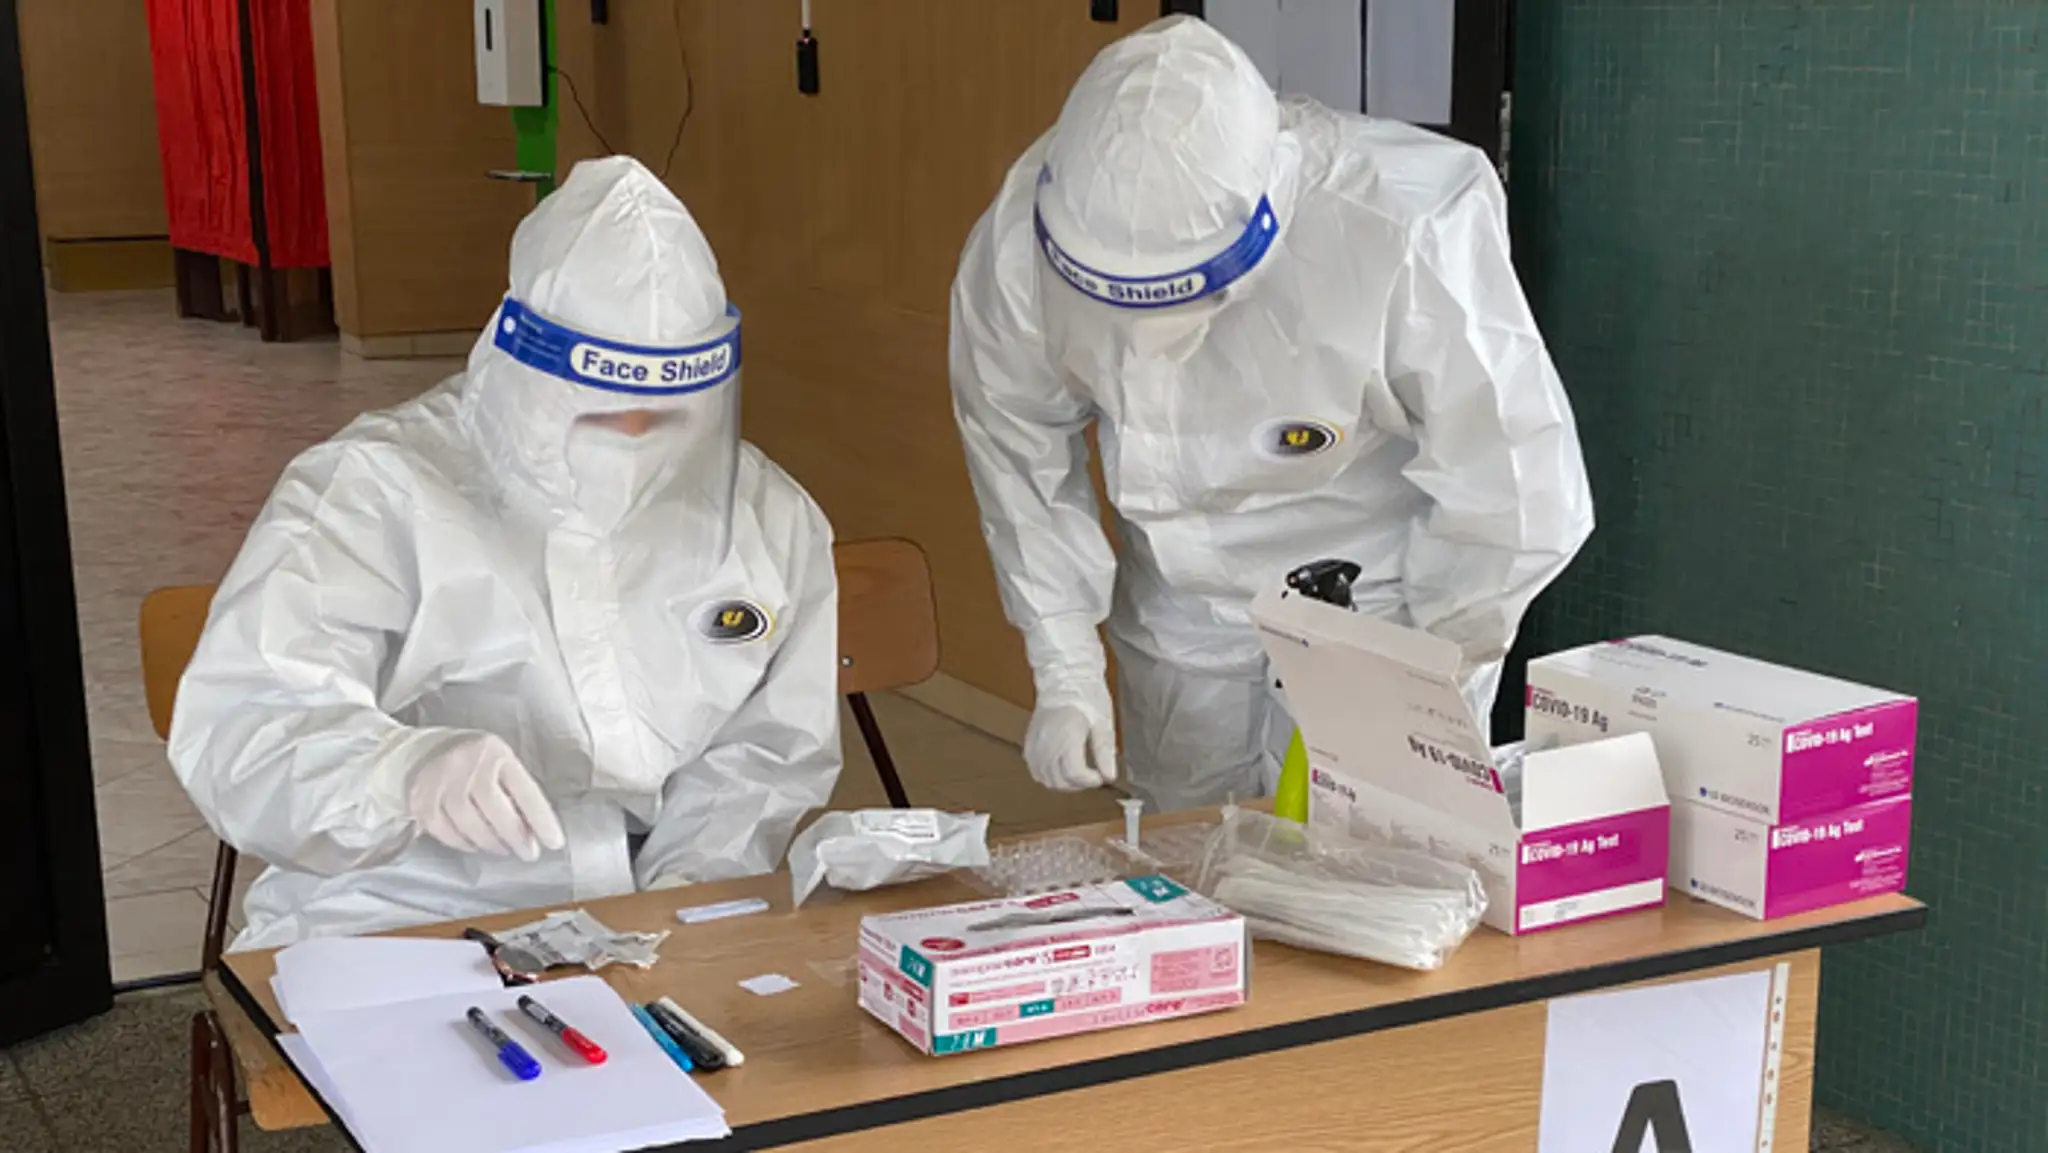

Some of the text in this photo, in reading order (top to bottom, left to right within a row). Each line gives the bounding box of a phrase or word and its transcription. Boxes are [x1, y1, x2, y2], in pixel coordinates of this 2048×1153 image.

[1107, 278, 1194, 300] Shield
[582, 348, 727, 382] Face Shield
[1532, 693, 1609, 733] COVID-19 Ag
[1581, 838, 1596, 855] Ag
[1597, 832, 1620, 849] Test
